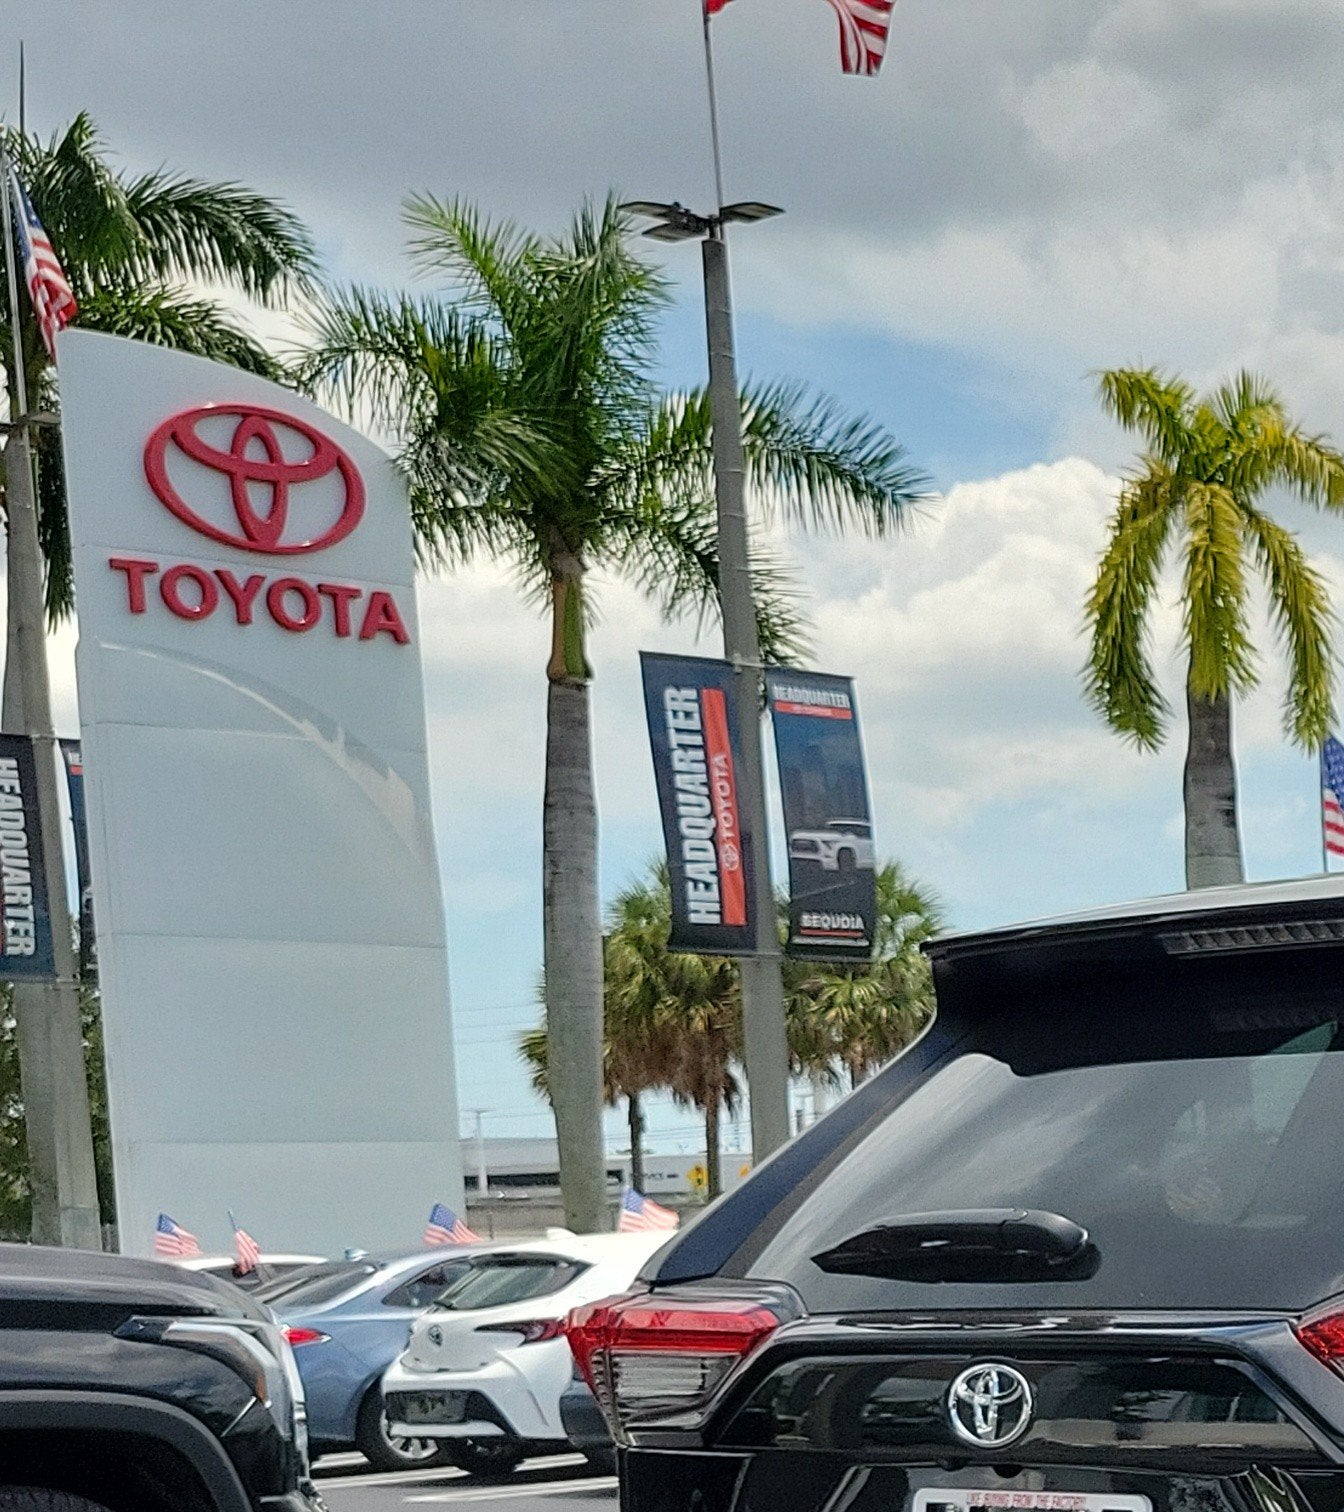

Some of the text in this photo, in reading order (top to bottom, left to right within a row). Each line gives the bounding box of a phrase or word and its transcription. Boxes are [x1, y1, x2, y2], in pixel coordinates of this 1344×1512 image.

[108, 556, 411, 646] TOYOTA
[663, 685, 722, 925] HEADQUARTER
[714, 753, 735, 838] TOYOTA
[801, 912, 865, 930] SEQUOIA
